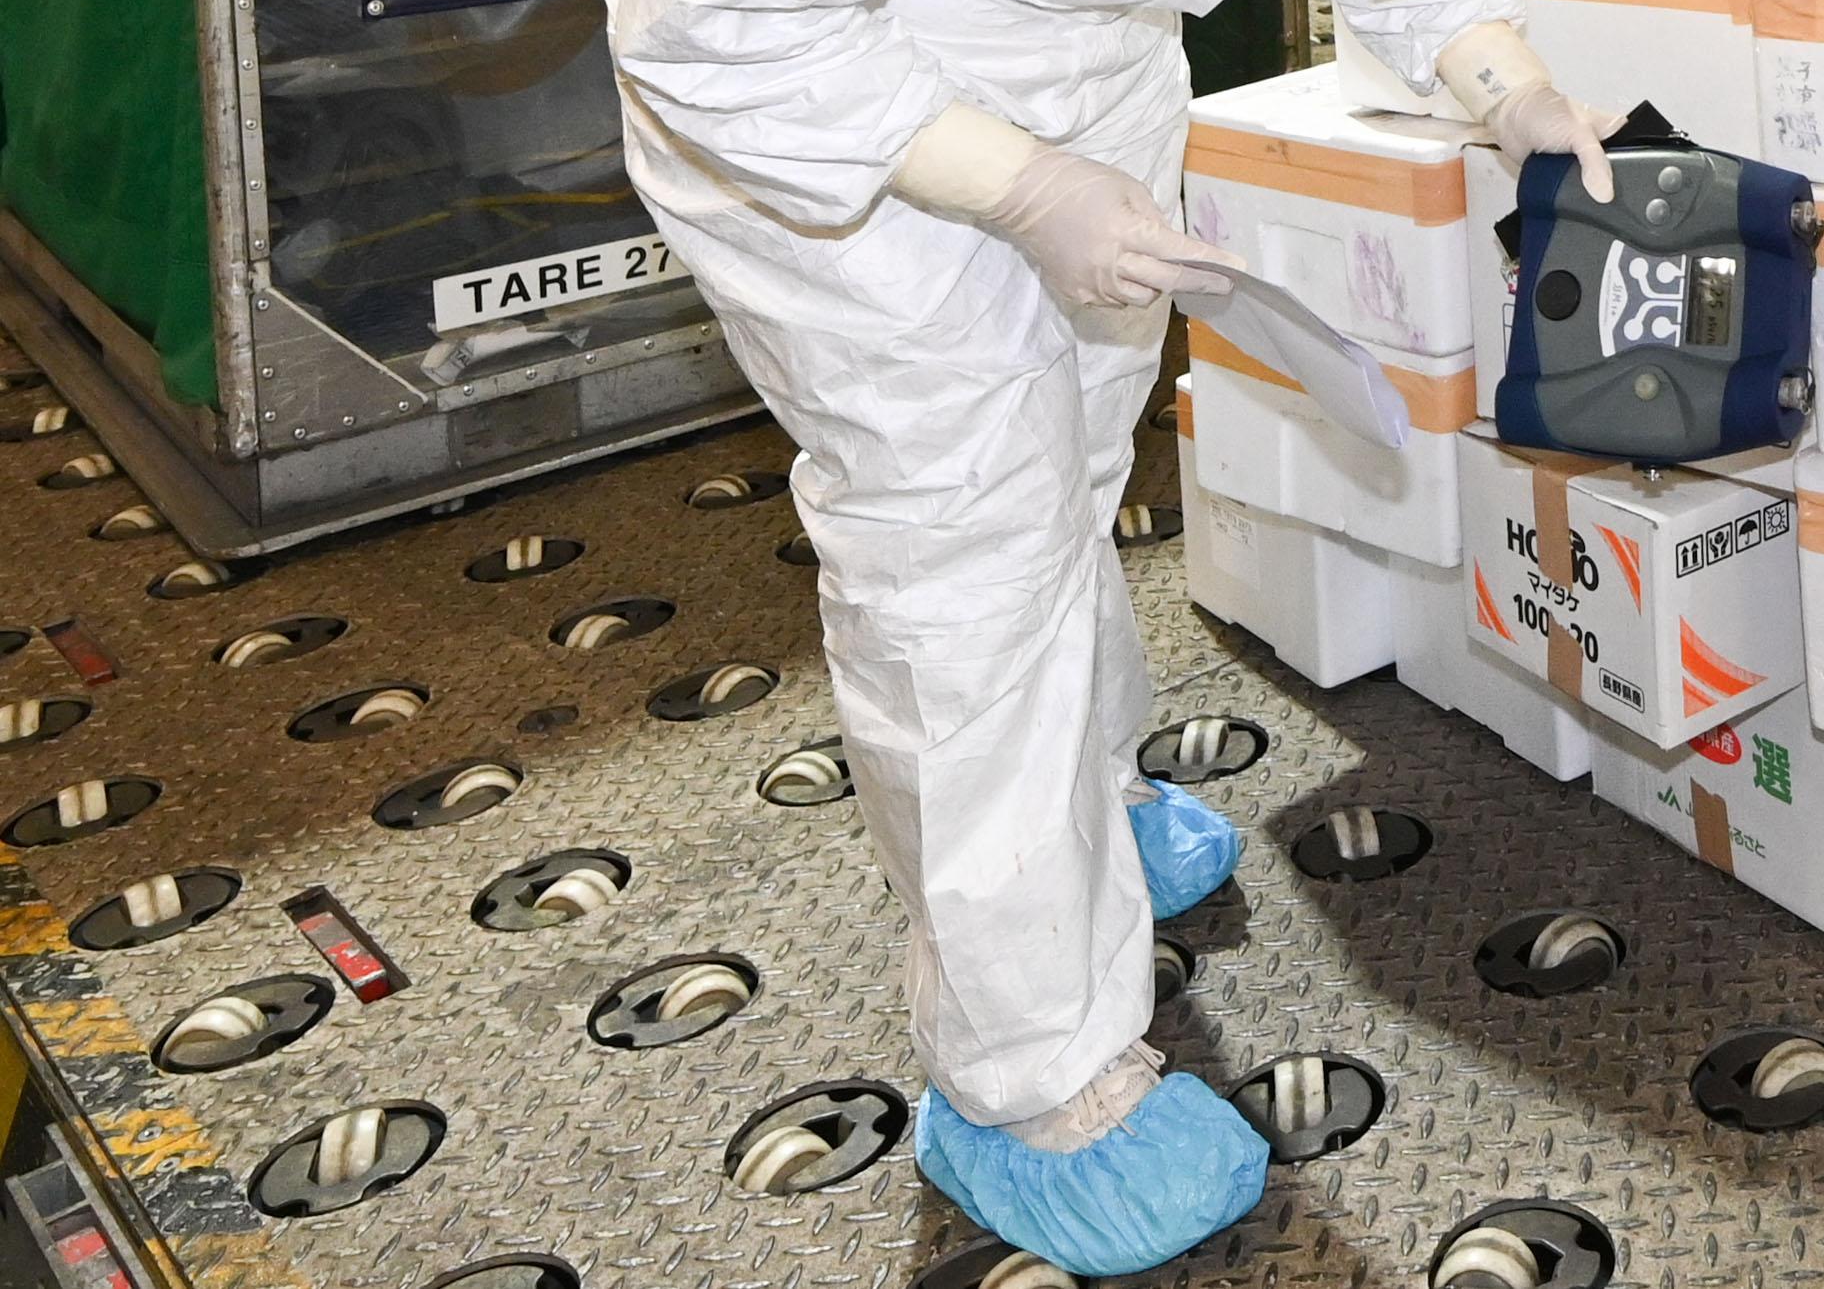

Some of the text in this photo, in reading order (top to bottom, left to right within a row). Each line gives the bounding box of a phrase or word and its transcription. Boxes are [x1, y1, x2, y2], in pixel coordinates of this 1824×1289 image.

[462, 254, 603, 313] TARE
[1602, 673, 1642, 708] 長野県産
[1751, 732, 1793, 806] 選
